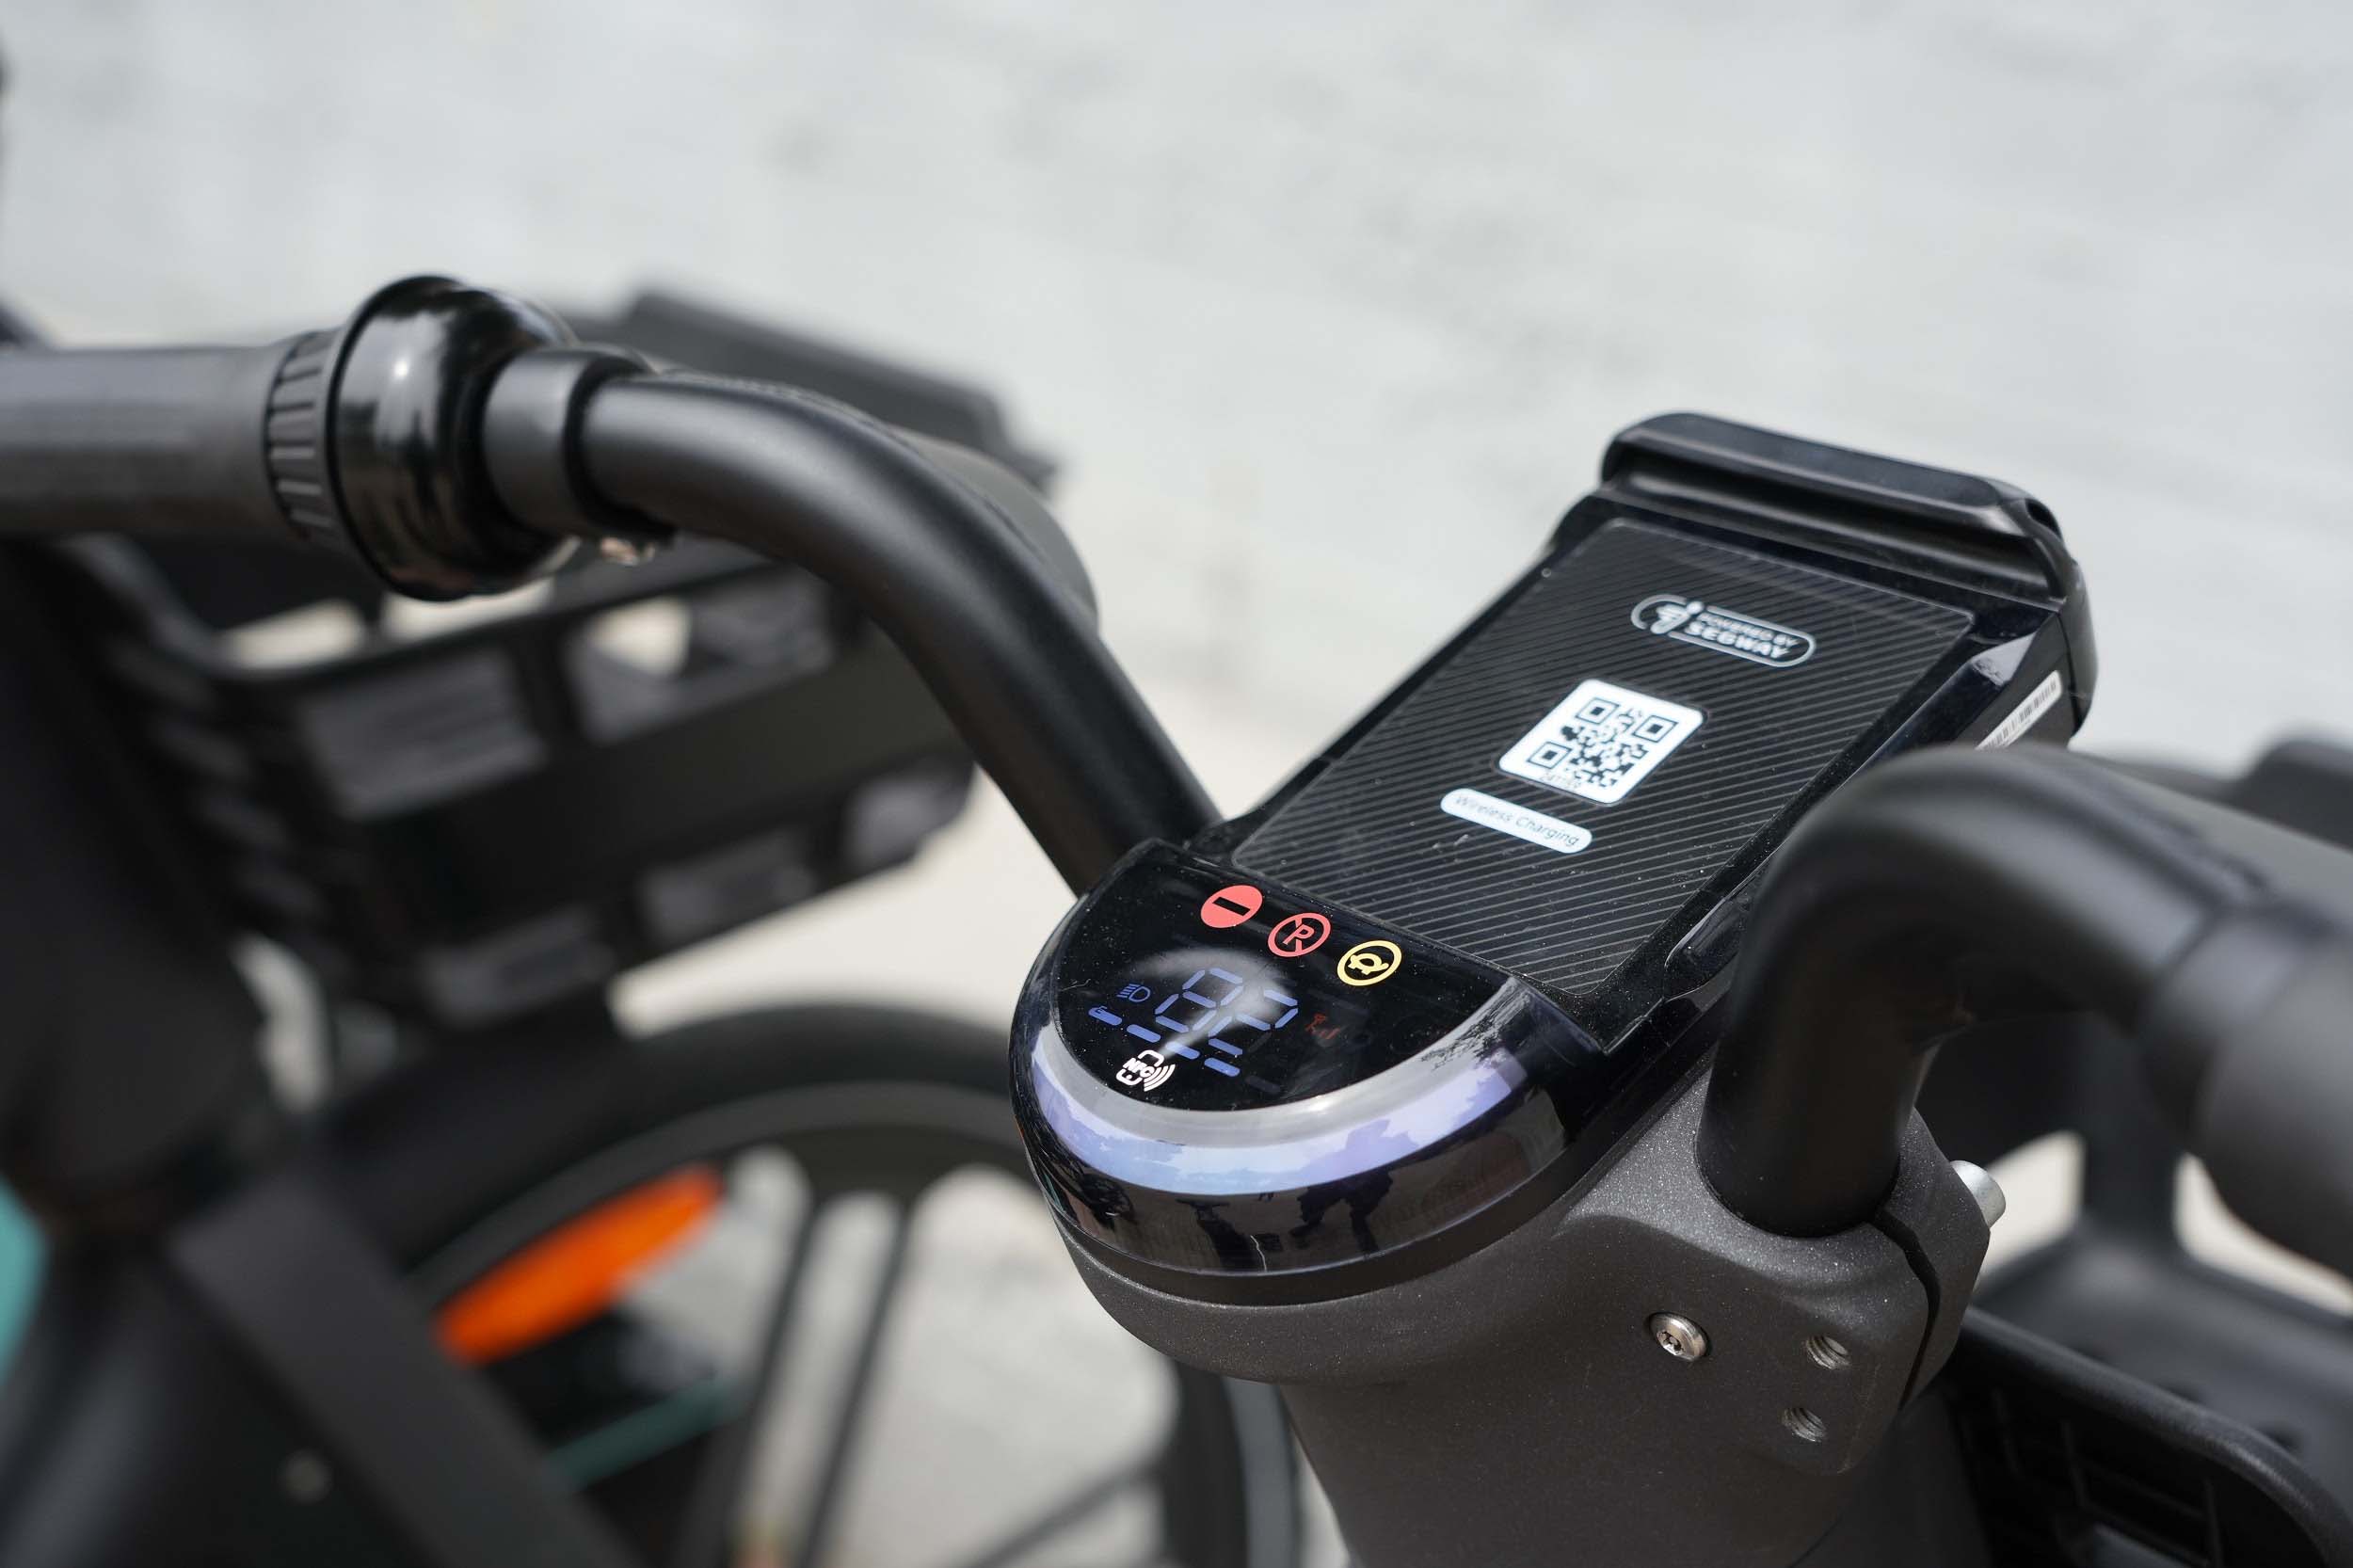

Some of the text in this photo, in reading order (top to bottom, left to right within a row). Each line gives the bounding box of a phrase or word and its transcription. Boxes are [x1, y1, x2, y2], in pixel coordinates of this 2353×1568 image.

[1684, 620, 1790, 659] SEGWAY
[1456, 793, 1580, 847] Wireless Charging
[1155, 967, 1299, 1056] 82
[1122, 1057, 1156, 1079] NFC
